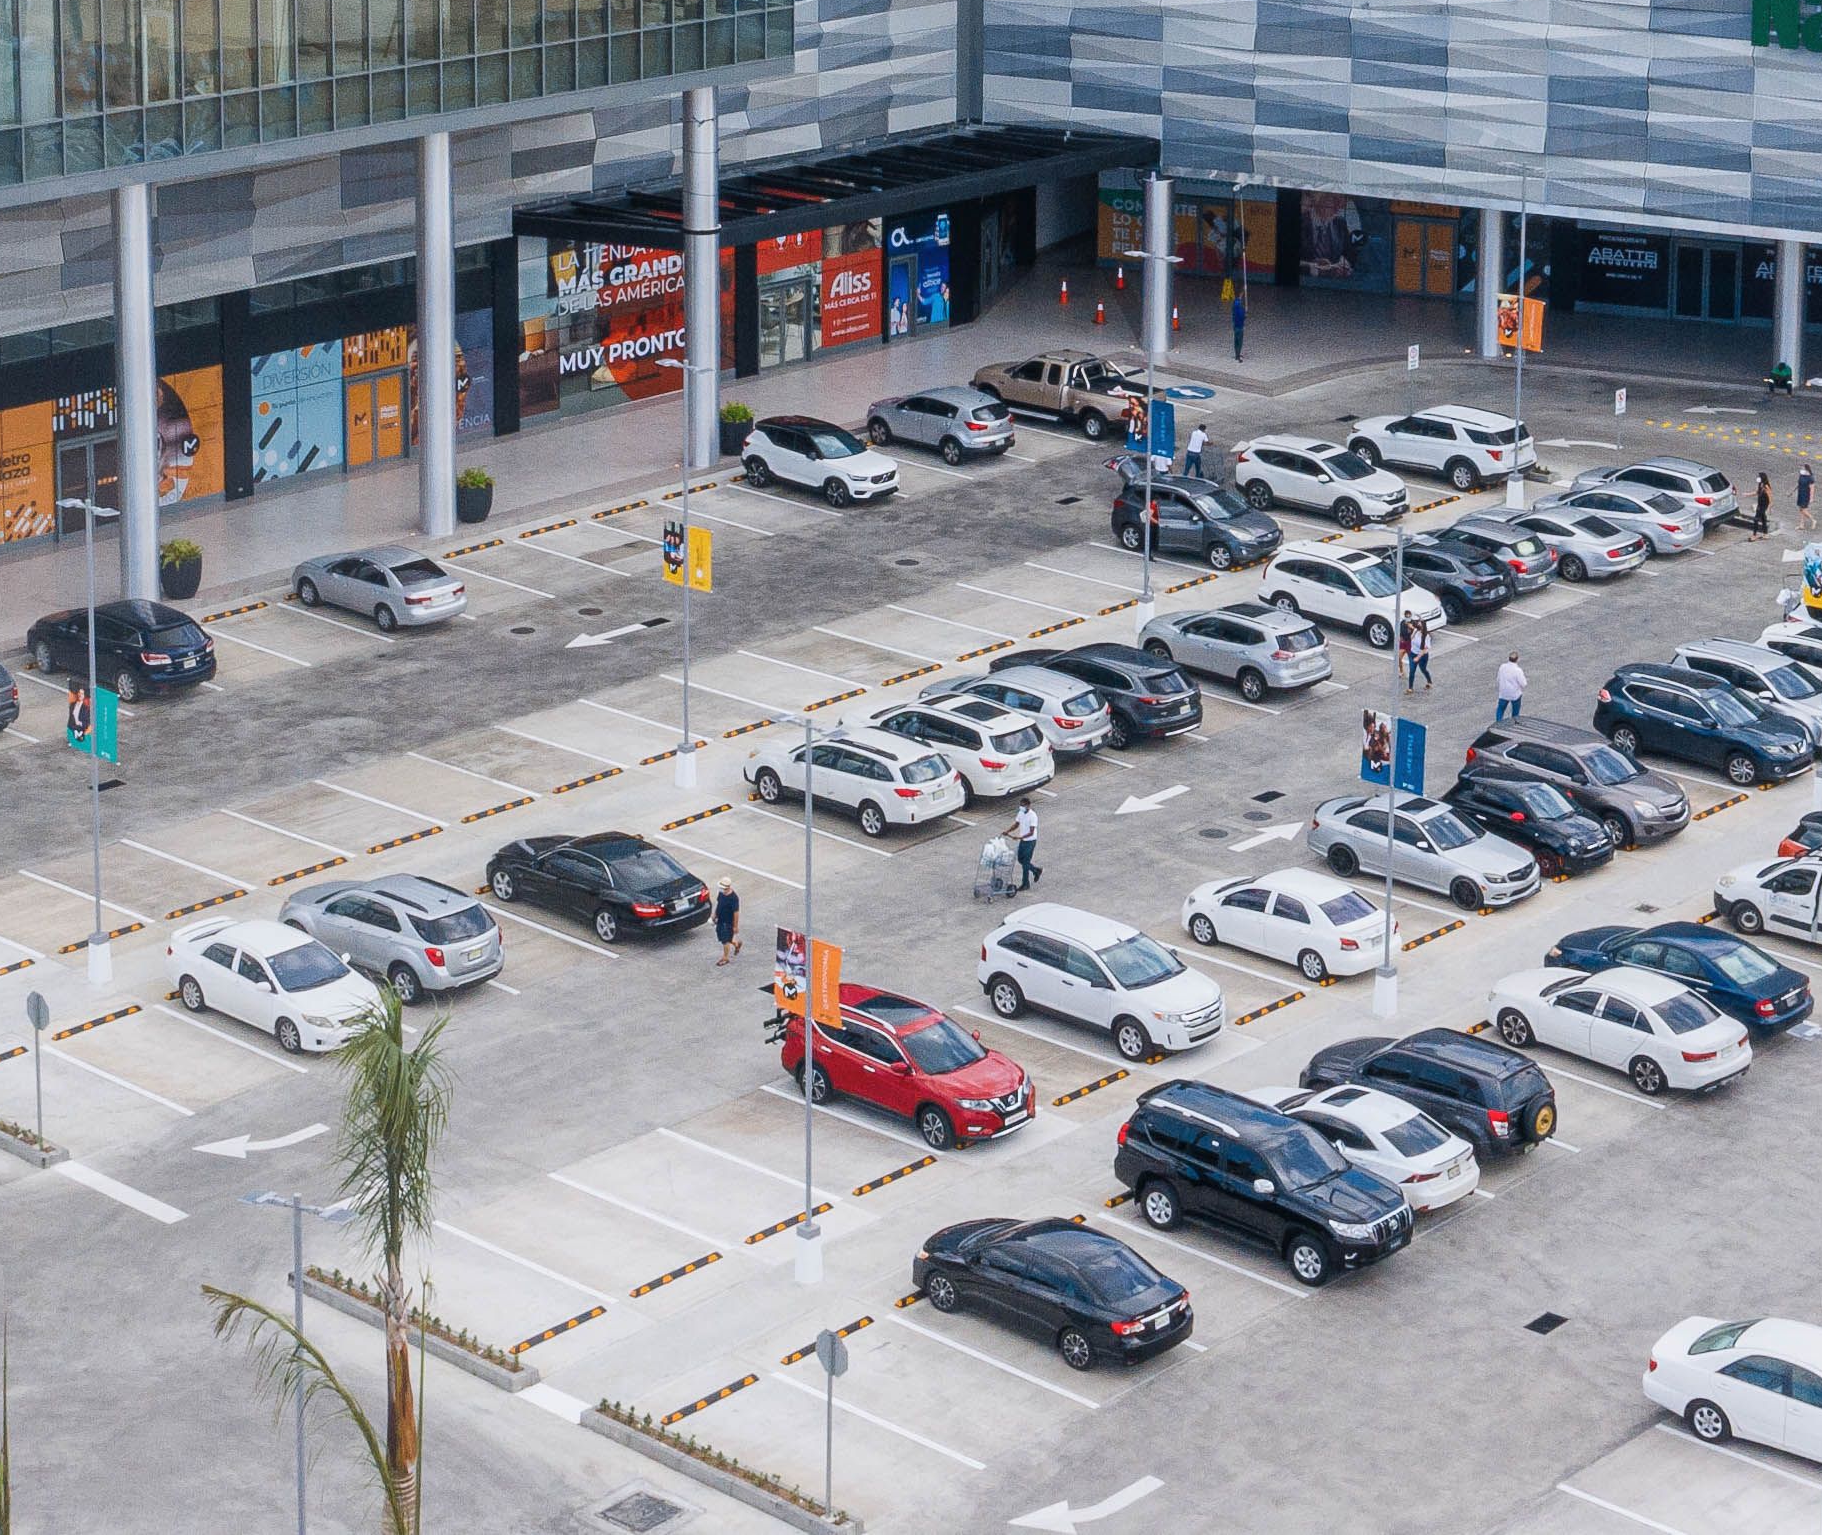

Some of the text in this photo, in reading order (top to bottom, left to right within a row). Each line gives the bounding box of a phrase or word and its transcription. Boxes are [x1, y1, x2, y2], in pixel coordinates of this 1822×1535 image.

[559, 249, 580, 272] LA
[559, 253, 685, 297] MÁS GRAND
[558, 276, 685, 317] DE LAS AMÉRICA
[830, 271, 871, 298] Aliss
[560, 327, 686, 374] MUY PRONTO
